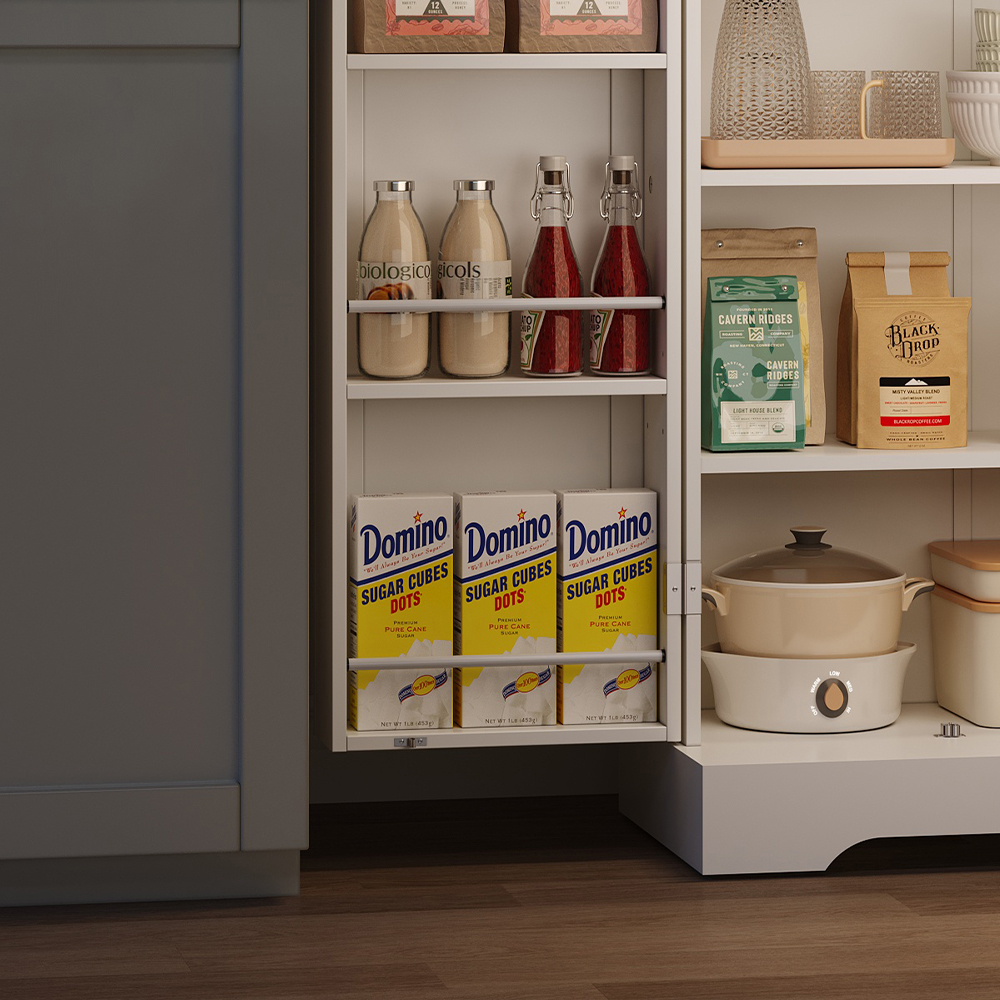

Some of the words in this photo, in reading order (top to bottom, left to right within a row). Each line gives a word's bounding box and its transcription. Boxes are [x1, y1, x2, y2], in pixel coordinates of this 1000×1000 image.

[430, 1, 441, 10] 12
[584, 1, 594, 10] 12
[718, 314, 756, 325] CAVERN
[758, 314, 793, 325] RIDGES
[884, 323, 940, 347] BLACK
[895, 337, 940, 360] DROP
[766, 360, 799, 370] CAVERN
[766, 371, 800, 380] RIDGES
[360, 516, 448, 566] Domino
[464, 513, 551, 563] Domino
[565, 511, 652, 561] Domino
[361, 578, 404, 605] SUGAR
[408, 562, 449, 590] CUBES
[465, 575, 508, 603] SUGAR
[512, 559, 552, 588] CUBES
[566, 573, 609, 600] SUGAR
[613, 557, 652, 585] CUBES
[390, 591, 421, 614] DOTS
[494, 588, 525, 612] DOTS
[595, 585, 625, 609] DOTS
